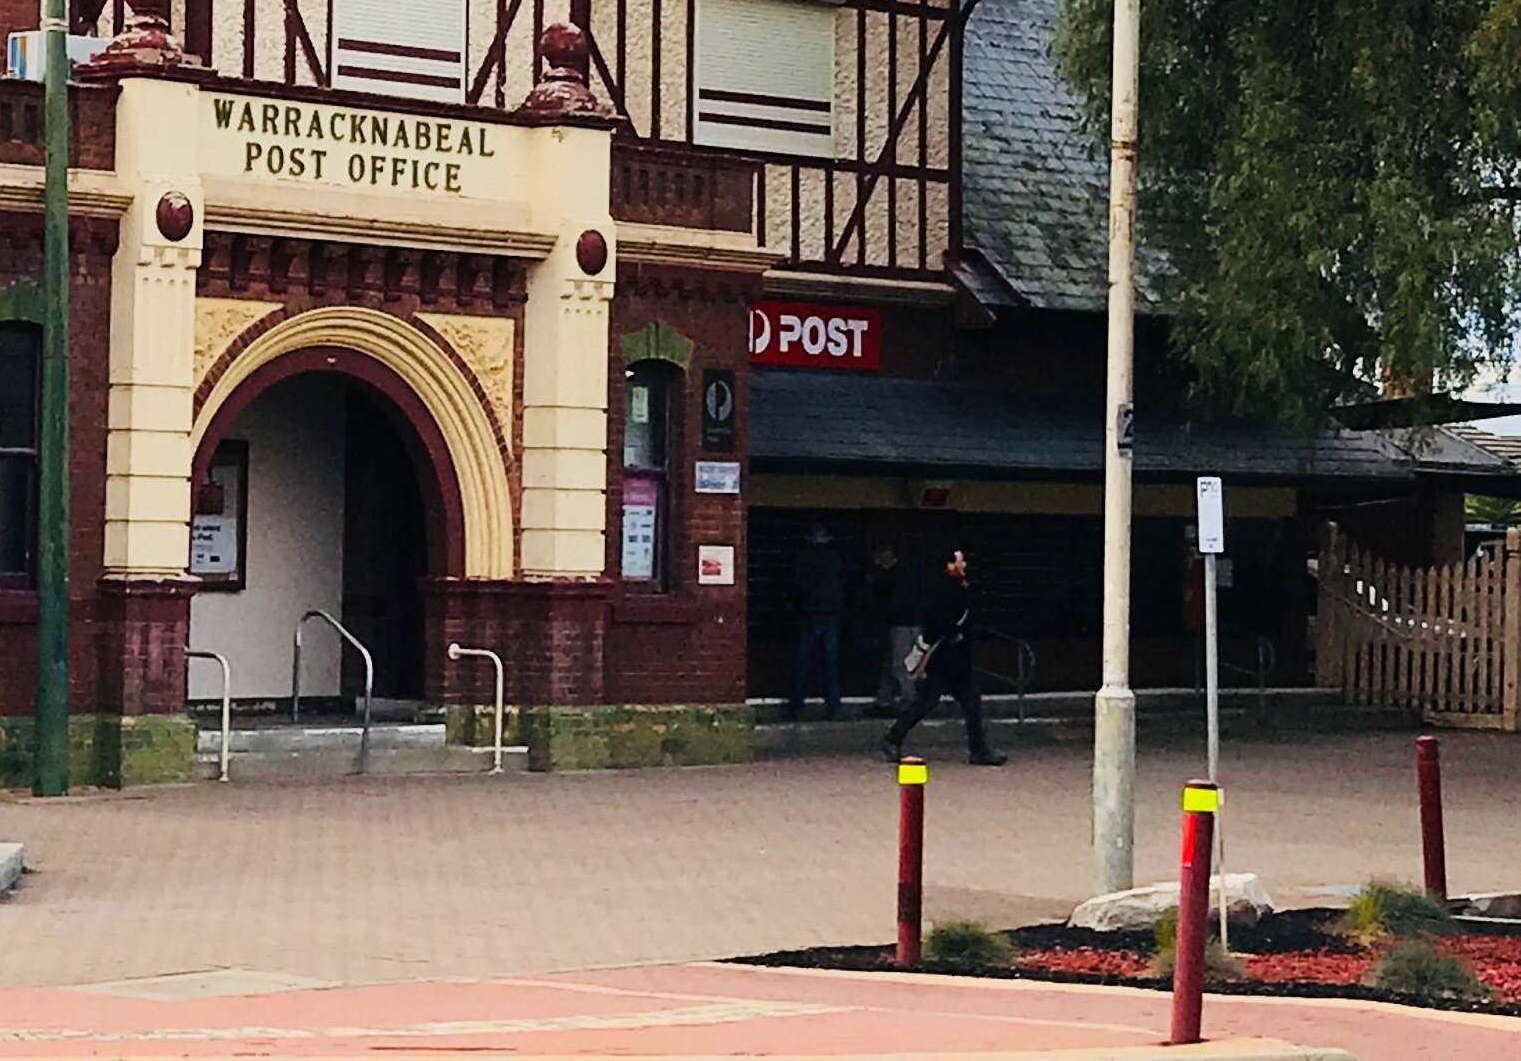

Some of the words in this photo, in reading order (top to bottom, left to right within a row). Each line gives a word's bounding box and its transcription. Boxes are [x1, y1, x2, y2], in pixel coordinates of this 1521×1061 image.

[213, 98, 495, 157] WARRACKNABEAL
[244, 142, 327, 179] POST
[348, 154, 462, 193] OFFICE
[779, 314, 869, 357] POST
